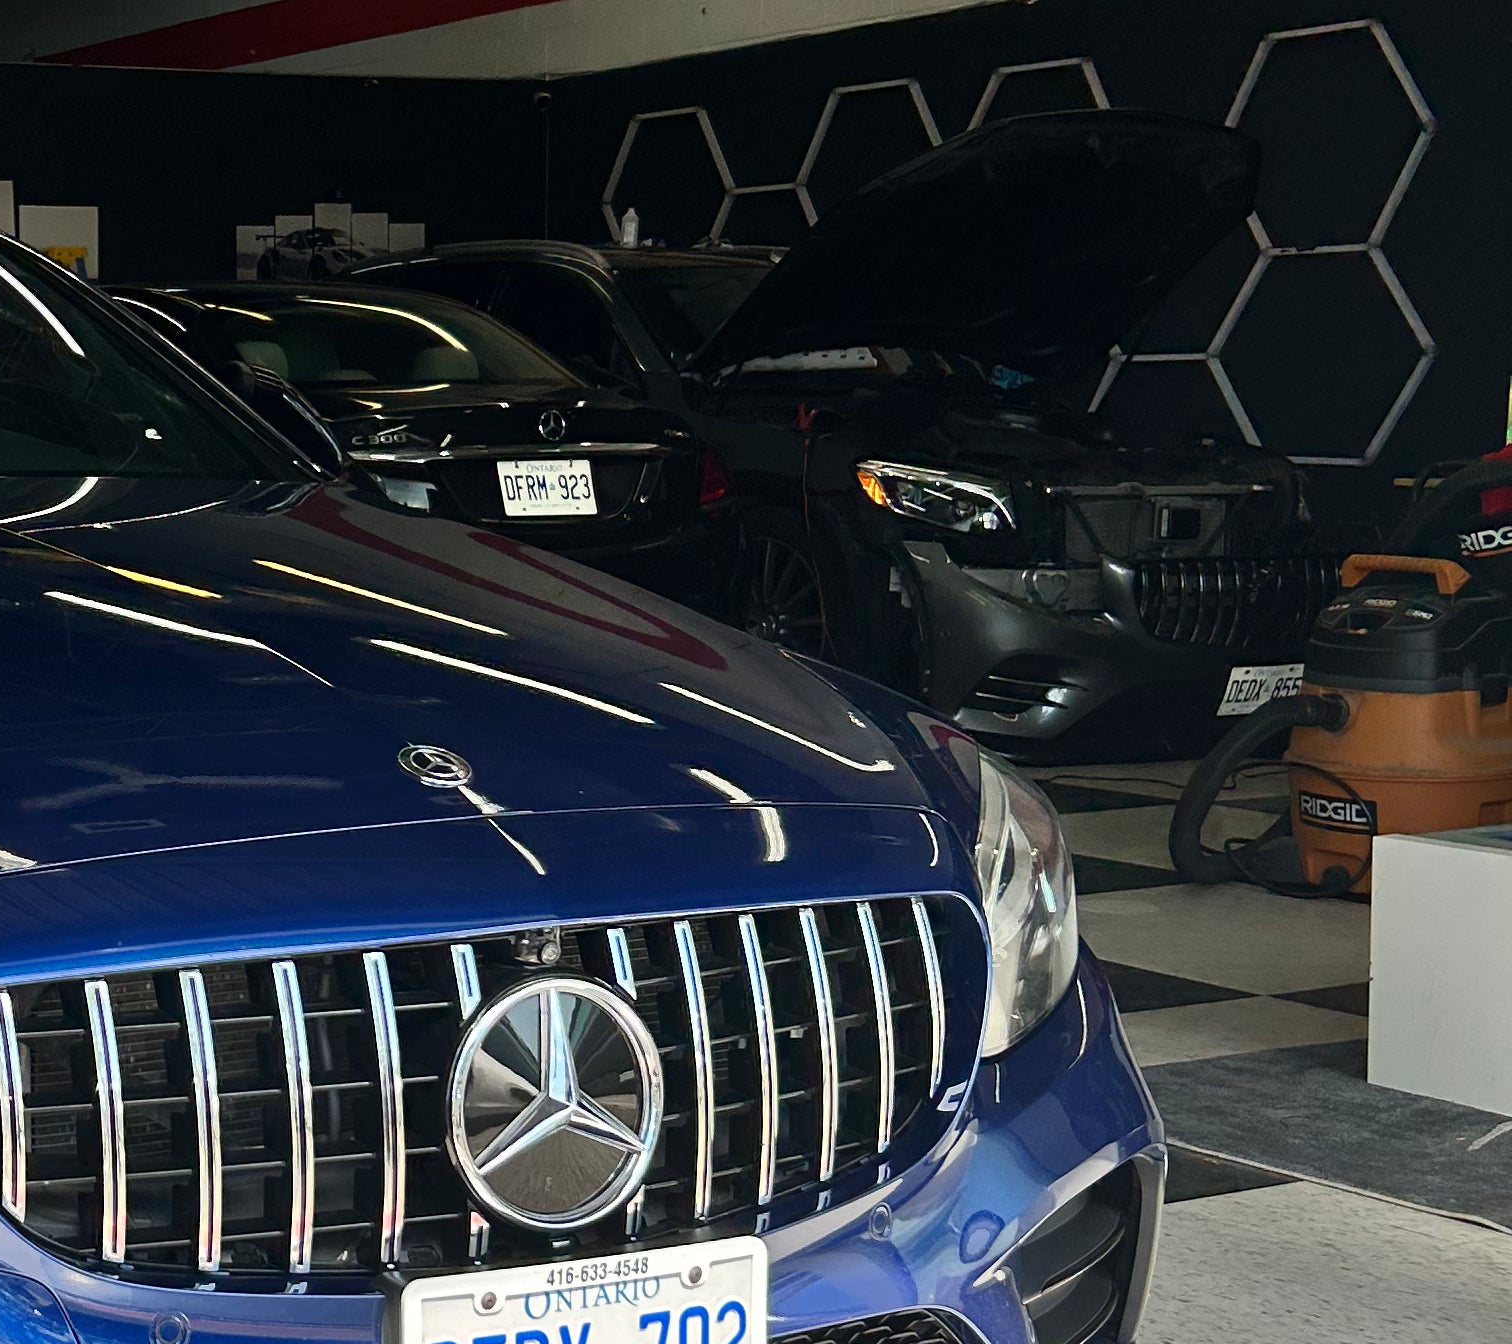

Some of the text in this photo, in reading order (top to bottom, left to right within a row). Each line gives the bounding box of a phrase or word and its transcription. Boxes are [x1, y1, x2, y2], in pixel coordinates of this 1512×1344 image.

[369, 434, 407, 445] 300
[504, 474, 591, 500] DFRM 923
[546, 1257, 649, 1286] 416-633-4548
[524, 1276, 660, 1319] ONTARIO
